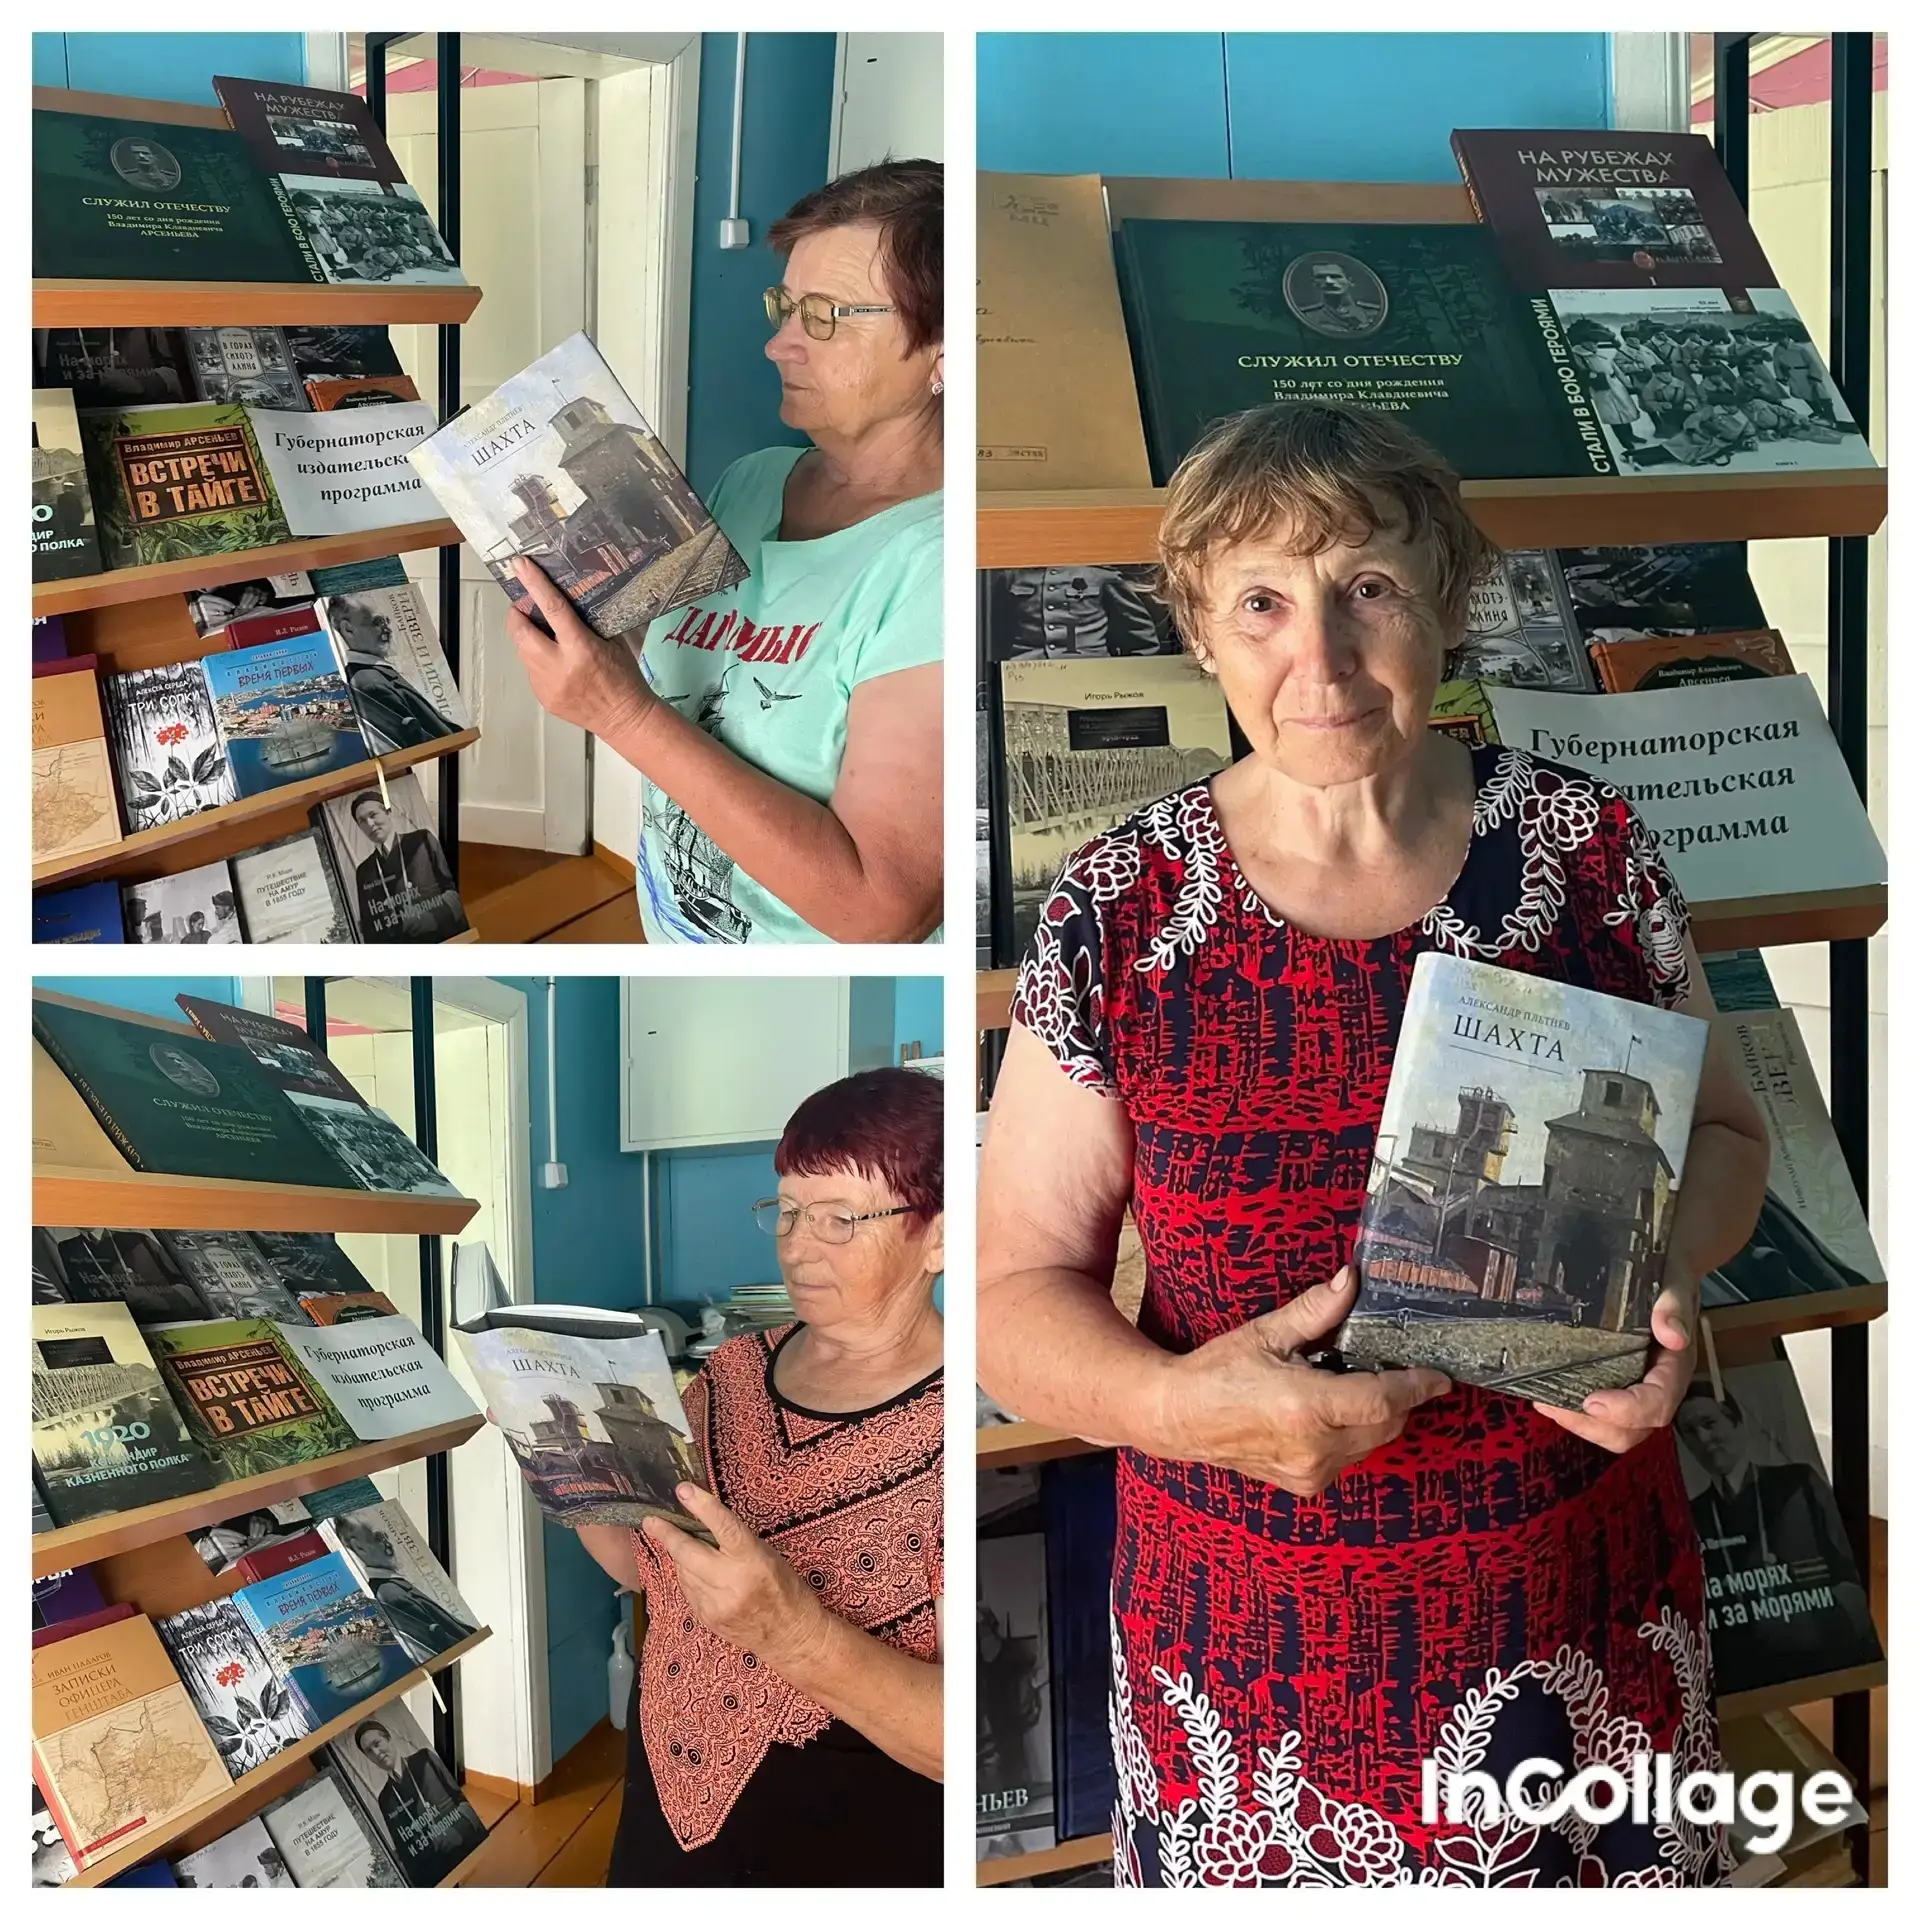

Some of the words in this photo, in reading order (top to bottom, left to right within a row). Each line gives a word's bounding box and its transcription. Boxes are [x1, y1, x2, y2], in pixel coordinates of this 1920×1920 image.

[253, 91, 279, 104] НА
[280, 95, 345, 111] РУБЕЖАХ
[1517, 149, 1559, 165] НА
[1561, 149, 1677, 167] РУБЕЖАХ
[1535, 166, 1677, 184] МУЖЕСТВА
[82, 197, 151, 209] СЛУЖИЛ
[153, 201, 231, 213] ОТЕЧЕСТВУ
[268, 177, 293, 217] ГЕРОЯМИ
[107, 220, 162, 230] Владимира
[140, 229, 199, 238] АРСЕНЬЕВА
[175, 217, 221, 225] рождения
[287, 217, 304, 241] БОЮ
[302, 250, 325, 282] СТАЛИ
[1530, 298, 1568, 366] ГЕРОЯМИ
[222, 341, 228, 350] В
[229, 341, 253, 350] ГОРАХ
[1237, 354, 1339, 368] СЛУЖИЛ
[1343, 353, 1464, 368] ОТЕЧЕСТВУ
[1272, 379, 1296, 389] 150
[1299, 380, 1324, 391] лет
[1327, 380, 1343, 389] со
[1346, 380, 1373, 389] дня
[1375, 377, 1445, 390] рождения
[1273, 390, 1354, 402] Владимира
[1357, 389, 1450, 400] Клавдиевича
[1557, 365, 1586, 406] БОЮ
[1573, 406, 1588, 417] В
[123, 439, 181, 454] Владимир
[183, 431, 239, 447] АРСЕНЬЕВ
[274, 425, 425, 453] Губернаторская
[471, 418, 537, 466] ШАХТА
[1577, 417, 1611, 474] СТАЛИ
[128, 449, 248, 486] ВСТРЕЧИ
[135, 490, 161, 518] В
[165, 474, 257, 513] ТАЙГЕ
[319, 477, 422, 504] программа
[39, 538, 85, 552] ПОЛКА
[397, 591, 424, 642] ЗВЕРИ
[238, 671, 273, 688] ВРЕМЯ
[274, 662, 315, 681] ПЕРВЫХ
[135, 684, 163, 697] АЛЕКСЕЙ
[164, 680, 190, 692] СЕРЕДА
[1084, 693, 1113, 701] Игорь
[128, 700, 156, 714] ТРИ
[159, 691, 201, 709] СОПКИ
[1530, 718, 1801, 765] Губернаторская
[1618, 766, 1796, 802] ательская
[1648, 812, 1790, 853] ограмма
[256, 871, 307, 895] ПУТЕШЕСТВИЕ
[268, 889, 280, 898] НА
[280, 882, 300, 895] АМУР
[288, 886, 306, 900] ГОДУ
[367, 898, 386, 916] На
[373, 918, 384, 932] и
[1459, 995, 1522, 1018] АЛЕКСАНДР
[1453, 1014, 1566, 1063] ШАХТА
[153, 1097, 211, 1113] СЛУЖИЛ
[211, 1107, 273, 1122] ОТЕЧЕСТВУ
[174, 1356, 228, 1370] Владимир
[227, 1344, 274, 1362] АРСЕНЬЕВ
[303, 1335, 416, 1365] Губернаторская
[330, 1359, 424, 1386] издательская
[512, 1358, 581, 1379] ШАХТА
[187, 1363, 295, 1402] ВСТРЕЧИ
[205, 1405, 236, 1433] В
[230, 1387, 314, 1426] ТАЙГЕ
[357, 1383, 431, 1412] программа
[80, 1421, 151, 1450] 1920
[65, 1461, 149, 1488] КАЗНЕННОГО
[149, 1453, 190, 1470] ПОЛКА
[1727, 1563, 1793, 1597] морях
[278, 1597, 308, 1616] ВРЕМЯ
[308, 1583, 341, 1607] ПЕРВЫХ
[1721, 1602, 1749, 1627] за
[1751, 1586, 1836, 1624] морями
[178, 1644, 205, 1660] ТРИ
[205, 1627, 244, 1651] СОПКИ
[47, 1663, 72, 1680] ИВАН
[52, 1664, 117, 1696] ЗАПИСКИ
[58, 1678, 122, 1708] ОФИЦЕРА
[64, 1687, 134, 1721] ГЕНШТАБА
[292, 1812, 337, 1846] ПУТЕШЕСТВИЕ
[304, 1837, 316, 1847] НА
[315, 1825, 332, 1840] АМУР
[397, 1824, 414, 1844] На
[304, 1848, 312, 1857] В
[311, 1839, 325, 1852] 1855
[323, 1828, 340, 1844] ГОДУ
[407, 1845, 417, 1858] и
[416, 1836, 430, 1852] за
